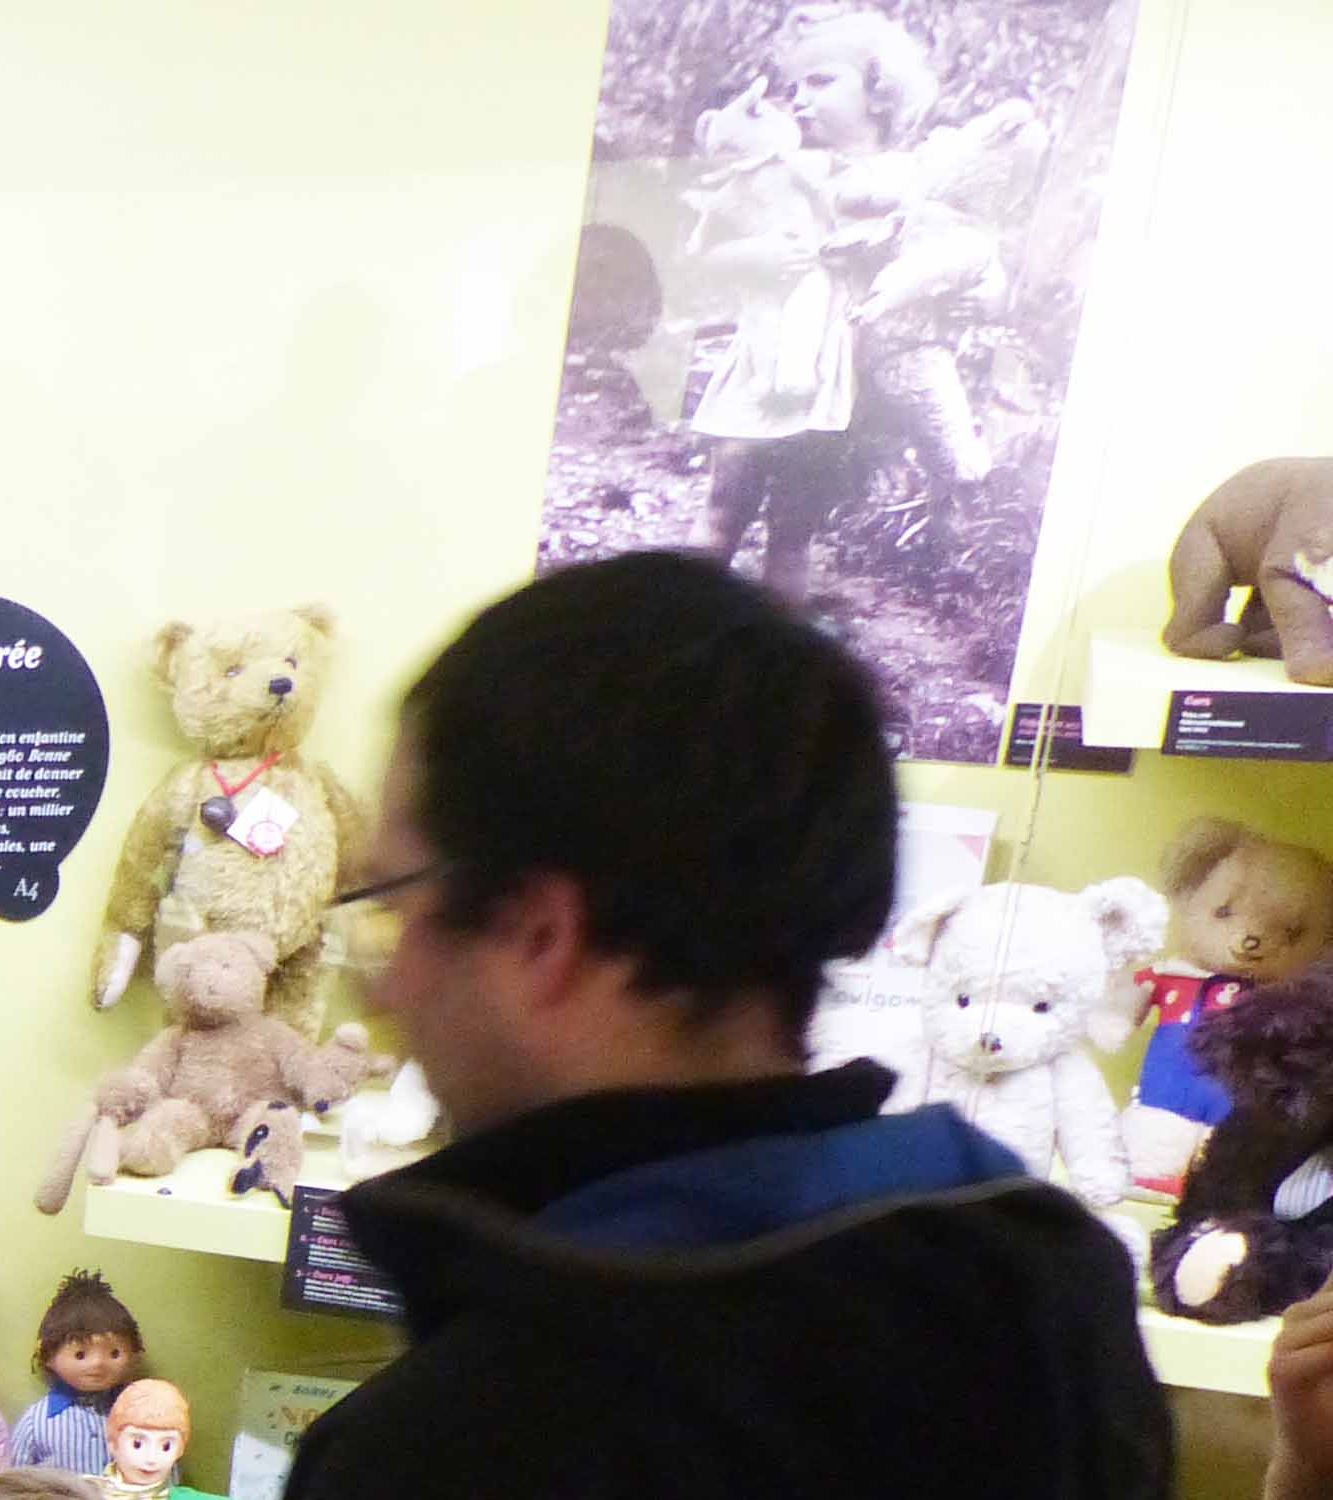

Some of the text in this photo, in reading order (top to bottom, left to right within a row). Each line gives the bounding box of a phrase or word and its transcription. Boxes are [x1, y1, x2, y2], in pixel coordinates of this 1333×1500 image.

[18, 731, 85, 747] enfantine
[28, 748, 72, 762] Bonne
[14, 767, 33, 780] de
[34, 767, 84, 781] donner
[8, 805, 26, 817] un
[29, 803, 74, 817] millier
[29, 840, 57, 853] une
[12, 877, 40, 901] A4
